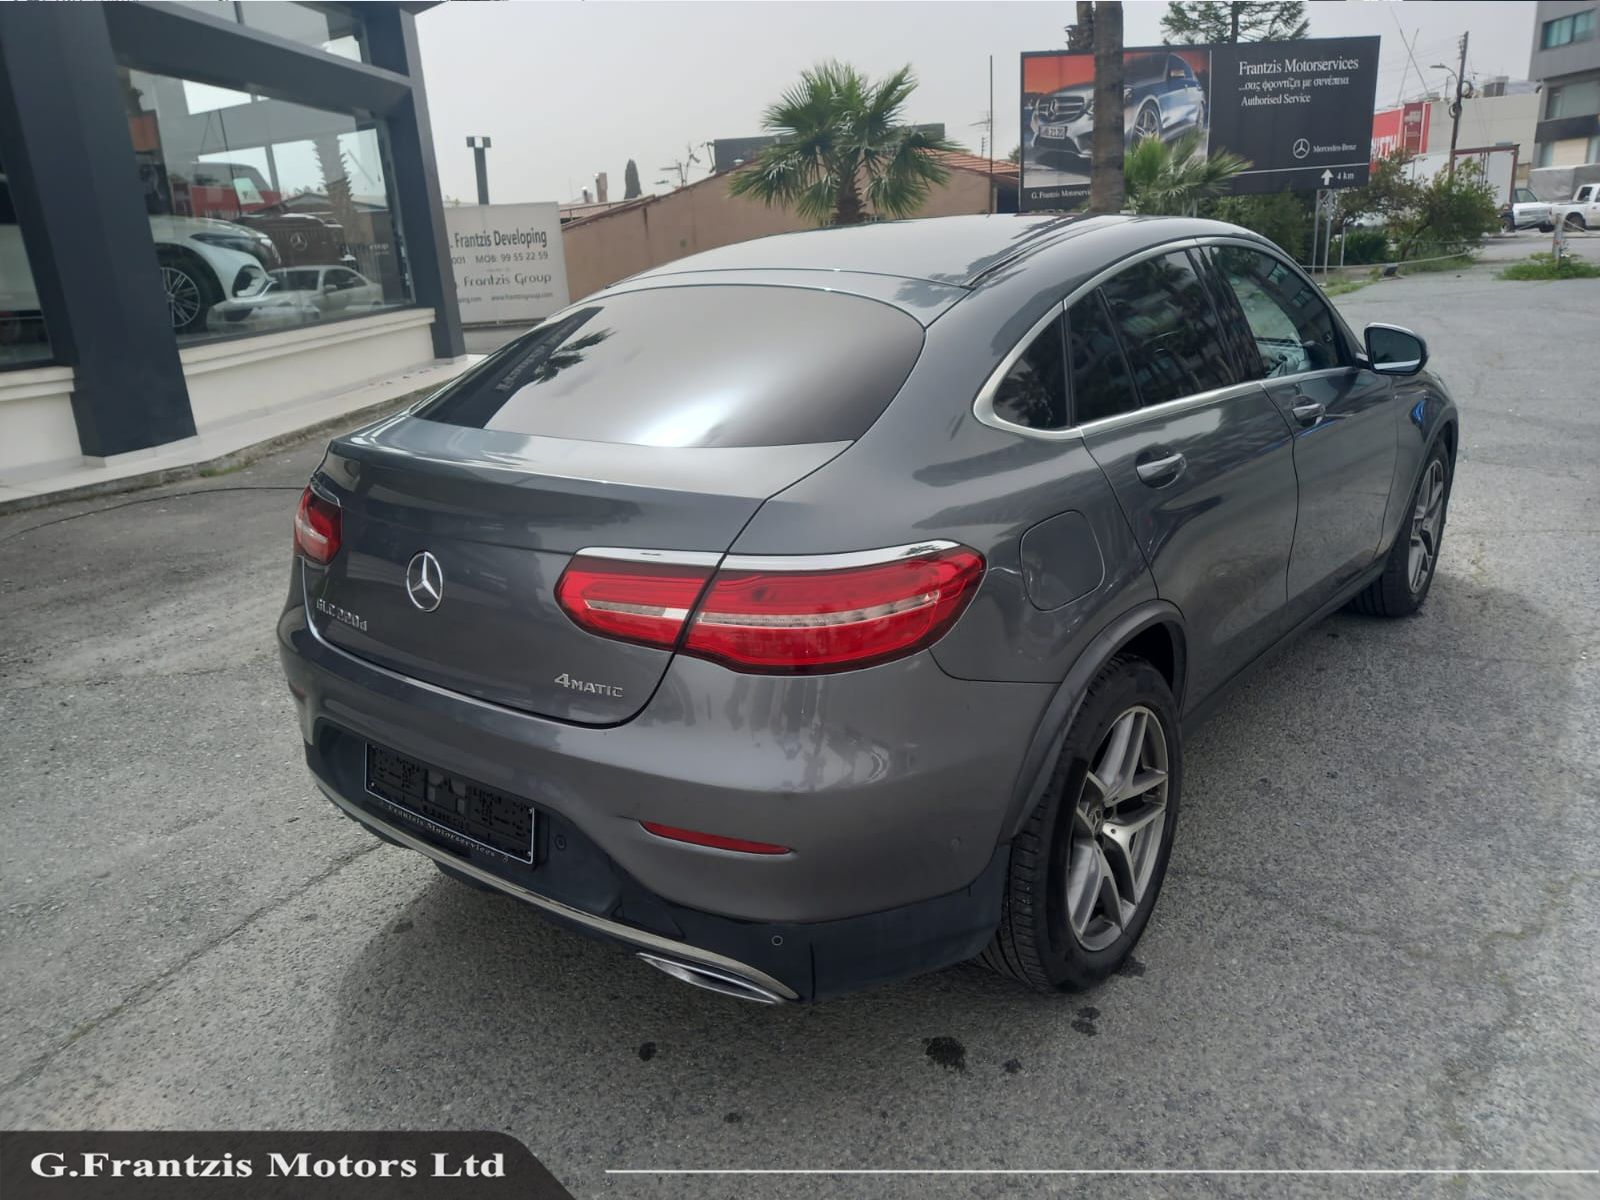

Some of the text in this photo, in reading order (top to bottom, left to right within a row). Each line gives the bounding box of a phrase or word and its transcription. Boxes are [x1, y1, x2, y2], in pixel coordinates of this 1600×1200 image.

[1239, 56, 1359, 75] Frantzis Motorservices
[1302, 78, 1312, 90] με
[1241, 92, 1311, 106] Authorised Service
[1343, 171, 1355, 180] km
[454, 227, 548, 249] Frantzis Developing
[451, 256, 466, 265] 001
[501, 253, 511, 262] 99
[513, 252, 524, 261] 55
[526, 252, 535, 260] 22
[538, 251, 548, 260] 59
[463, 273, 551, 287] Frantzis Group
[554, 673, 624, 698] 4MATIC
